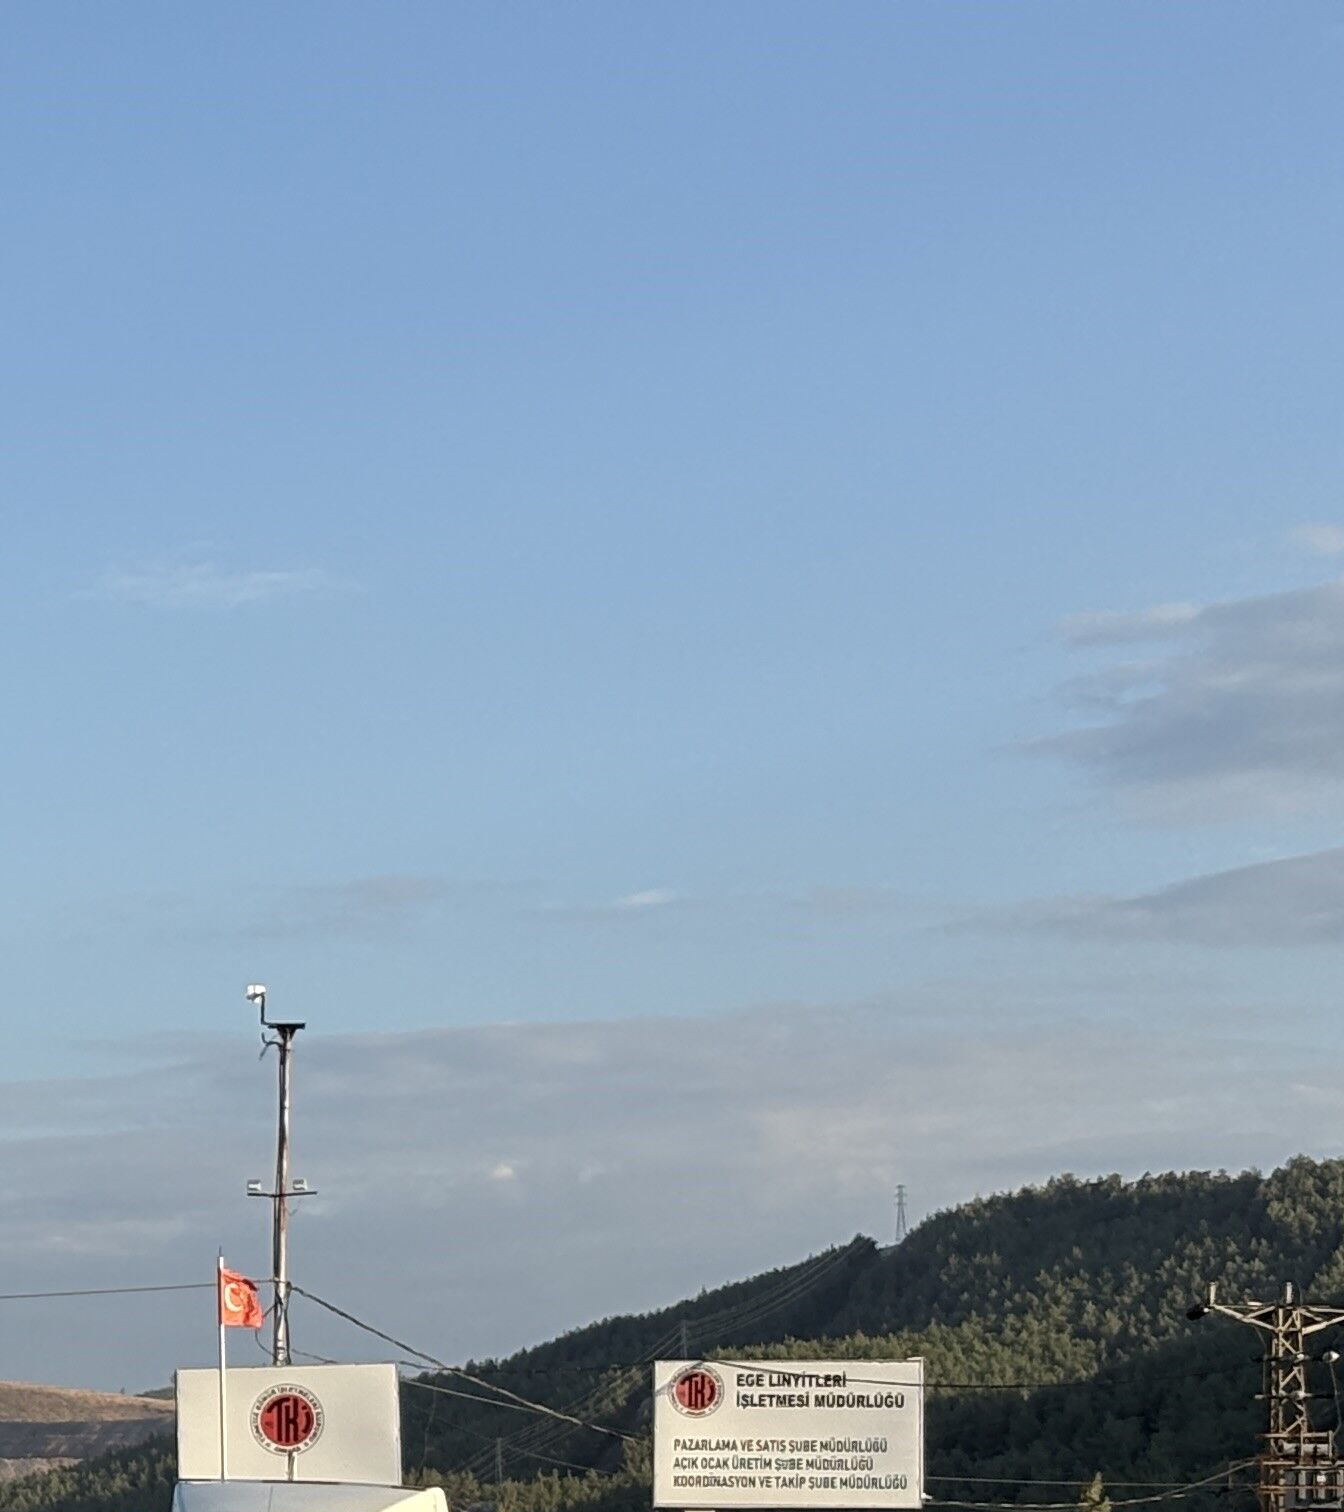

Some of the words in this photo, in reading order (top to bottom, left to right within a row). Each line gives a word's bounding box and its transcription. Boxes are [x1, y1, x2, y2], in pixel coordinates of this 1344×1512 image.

[736, 1373, 765, 1387] EGE
[736, 1391, 810, 1409] İŞLETMESİ
[814, 1392, 905, 1408] MÜDÜRLÜĞÜ
[673, 1438, 737, 1452] PAZARLAMA
[740, 1439, 753, 1452] VE
[788, 1440, 818, 1453] ŞUBE
[819, 1437, 888, 1453] MÜDÜRLÜĞÜ
[673, 1457, 698, 1470] AÇIK
[701, 1457, 730, 1469] OCAK
[732, 1454, 772, 1470] ÜRETİM
[774, 1458, 803, 1471] ŞUBE
[805, 1455, 873, 1471] MÜDÜRLÜĞÜ
[673, 1472, 756, 1487] KOORDİNASYON
[758, 1476, 772, 1488] VE
[774, 1473, 806, 1489] TAKİP
[808, 1476, 838, 1490] ŞUBE
[840, 1473, 907, 1490] MÜDÜRLÜĞÜ
